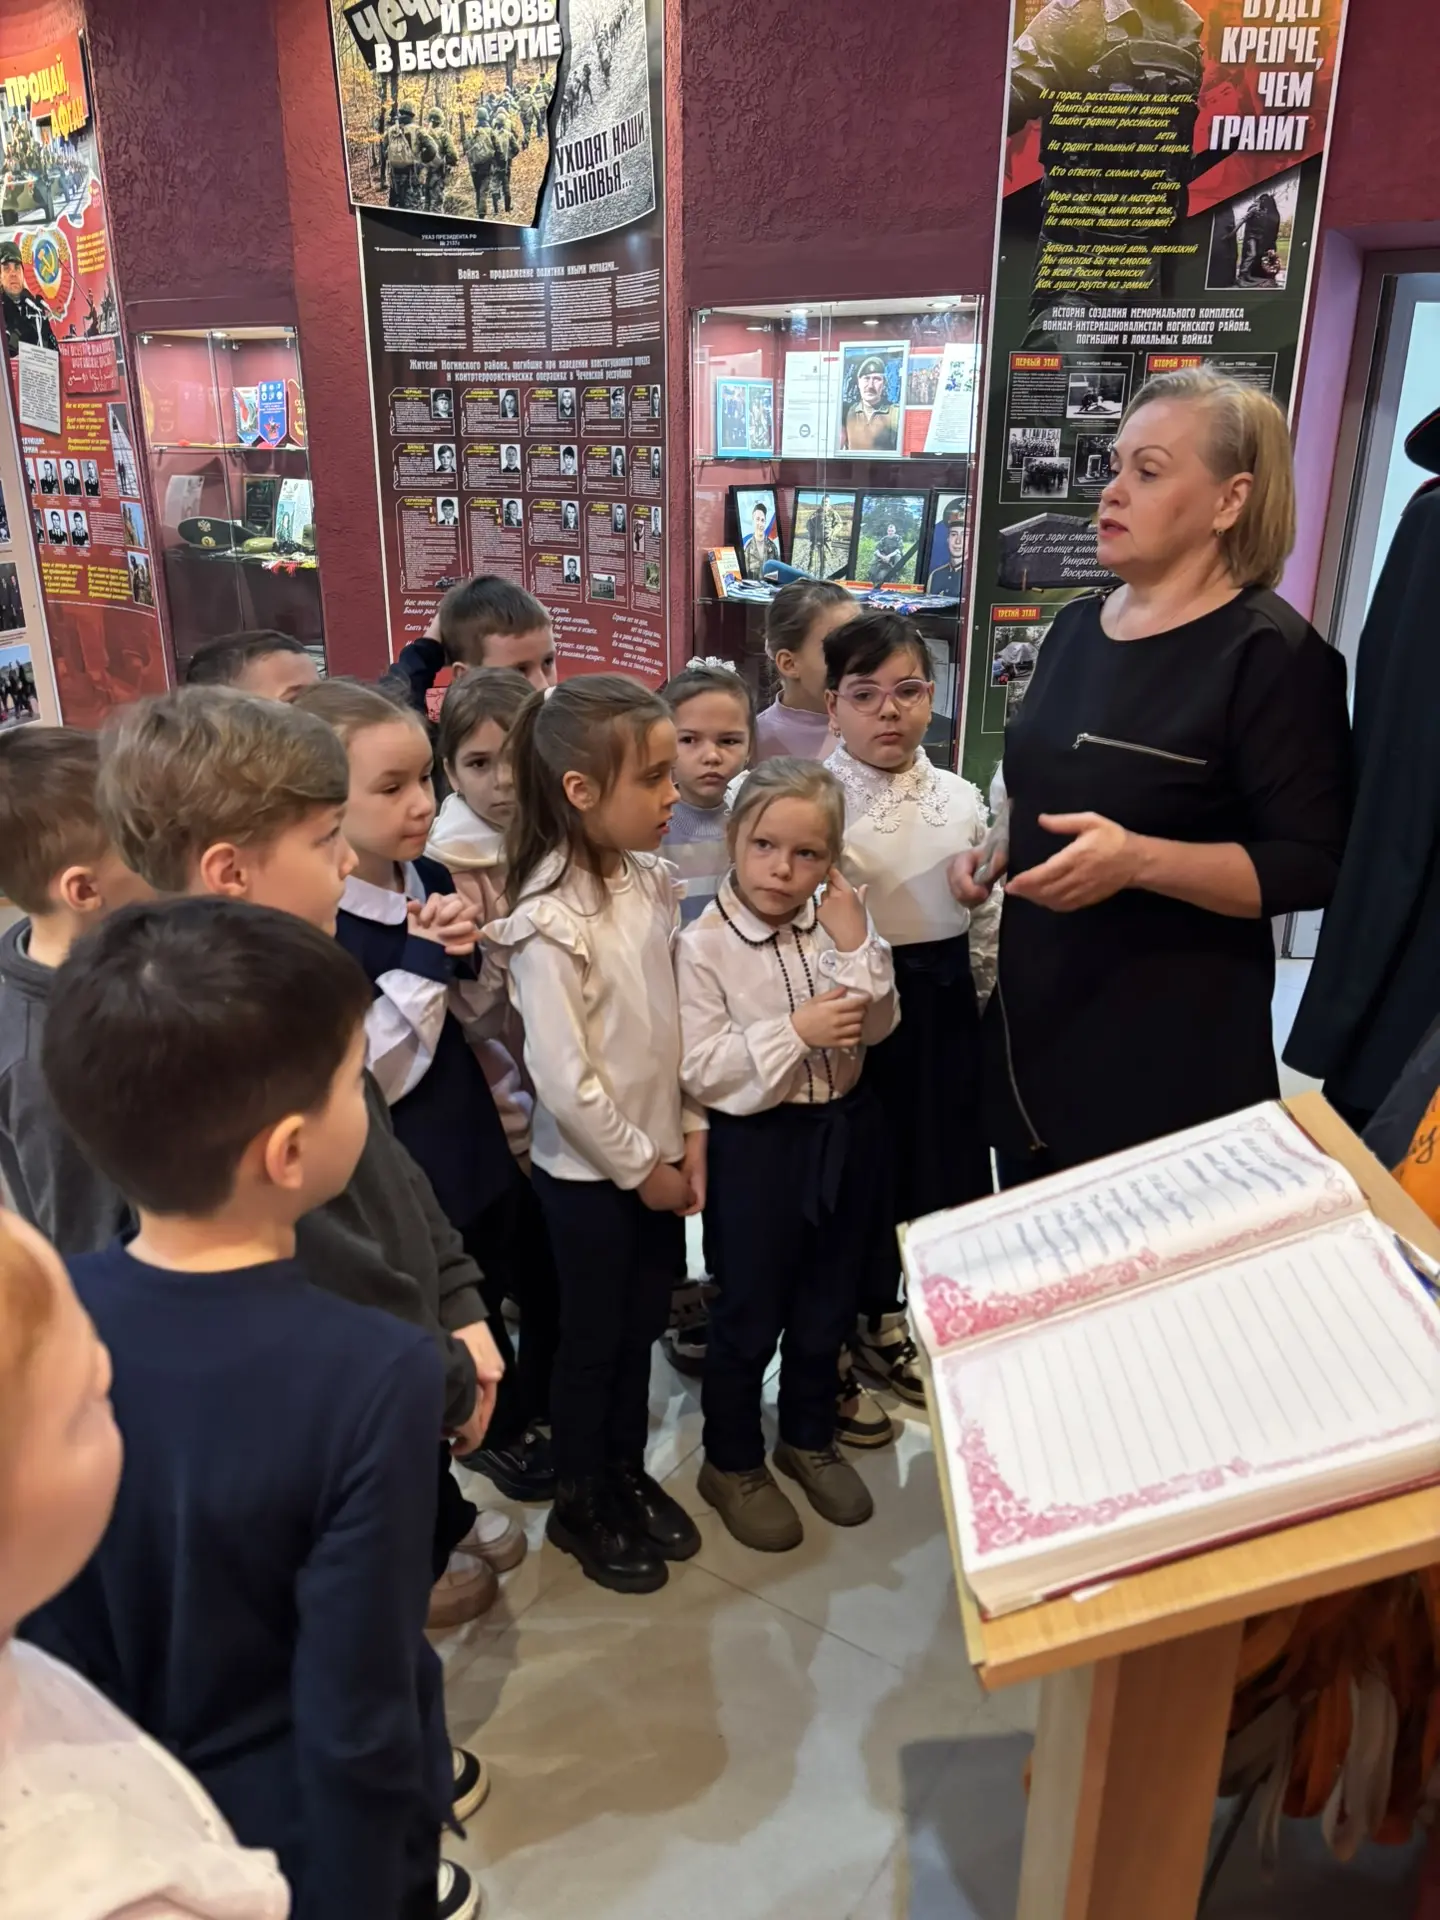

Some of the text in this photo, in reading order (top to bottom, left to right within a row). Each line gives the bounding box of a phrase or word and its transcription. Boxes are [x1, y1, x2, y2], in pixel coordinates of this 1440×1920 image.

[440, 0, 557, 35] И ВНОВЬ
[374, 24, 561, 73] В БЕССМЕРТИЕ
[1220, 27, 1324, 70] КРЕПЧЕ,
[1039, 88, 1049, 99] И
[1083, 91, 1150, 103] расставленных
[1152, 93, 1169, 102] как
[1258, 72, 1313, 107] ЧЕМ
[1052, 102, 1091, 113] Налитых
[1092, 105, 1129, 114] слезами
[1129, 105, 1137, 114] и
[1049, 114, 1170, 129] Падают равнин российских
[1154, 131, 1177, 141] дети
[1209, 115, 1309, 150] ГРАНИТ
[556, 111, 645, 176] УХОДЯТ НАШИ
[1048, 139, 1060, 150] На
[1062, 142, 1093, 153] гранит
[1093, 141, 1136, 152] холодный
[1136, 143, 1157, 152] вниз
[1049, 166, 1067, 177] Кто
[1105, 168, 1139, 177] сколько
[1140, 169, 1166, 180] будет
[554, 160, 632, 210] СЫНОВЬЯ...
[1152, 181, 1181, 190] стоить
[1047, 190, 1072, 203] Море
[1072, 193, 1090, 201] слез
[1093, 193, 1118, 203] отцов
[1119, 193, 1127, 202] и
[1048, 203, 1107, 215] Выплаканных
[1109, 206, 1128, 215] ими
[1129, 206, 1153, 215] после
[1045, 215, 1057, 226] На
[1058, 216, 1094, 226] могилах
[1097, 217, 1130, 227] павших
[1043, 242, 1074, 253] Забыть
[1076, 244, 1090, 253] тот
[1091, 244, 1127, 255] горький
[1151, 244, 1199, 253] неблизкий
[1040, 254, 1056, 265] Мы
[1057, 256, 1092, 265] никогда
[1107, 257, 1120, 265] не
[1037, 267, 1051, 277] По
[1052, 267, 1072, 277] всей
[1072, 267, 1104, 278] России
[1036, 278, 1052, 289] Как
[1053, 280, 1077, 291] души
[1077, 280, 1107, 291] рвутся
[1108, 281, 1119, 289] из
[1052, 307, 1244, 319] ИСТОРИЯ СОЗДАНИЯ МЕМОРИАЛЬНОГО КОМПЛЕКСА
[1042, 320, 1163, 332] ВОИНАМ-ИНТЕРНАЦИОНАЛИСТАМ
[1166, 321, 1215, 332] НОГИНСКОГО
[1076, 333, 1214, 345] ПОГИБШИМ В ЛОКАЛЬНЫХ ВОЙНАХ
[409, 359, 438, 370] Жители
[441, 359, 481, 370] Ногинского
[1015, 357, 1041, 367] ПЕРВЫЙ
[1020, 531, 1045, 543] Будут
[1046, 533, 1067, 543] зори
[1017, 543, 1043, 555] Будет
[1043, 545, 1074, 554] солнце
[1060, 556, 1098, 567] Умирать
[1061, 567, 1109, 579] Воскресать
